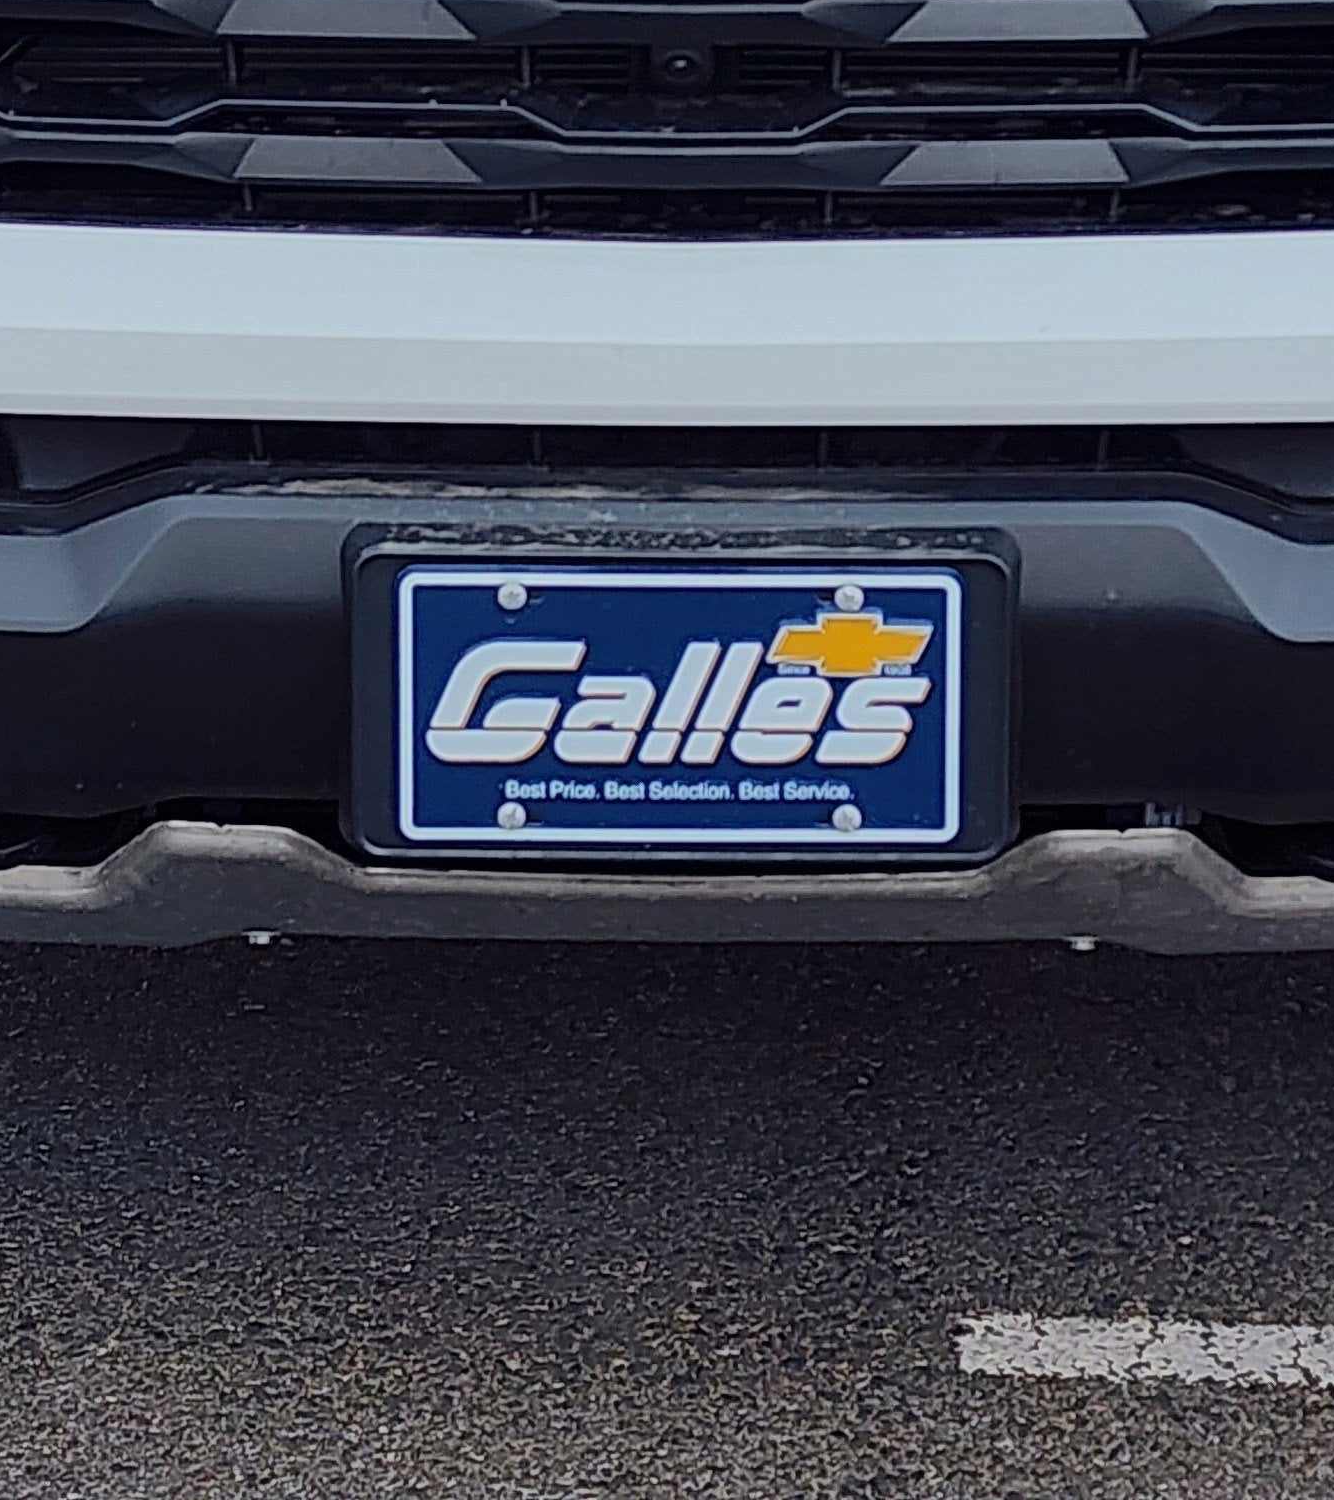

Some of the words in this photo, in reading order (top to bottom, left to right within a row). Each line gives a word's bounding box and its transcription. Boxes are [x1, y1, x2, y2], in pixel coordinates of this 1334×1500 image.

[425, 640, 932, 764] Galles
[505, 779, 546, 799] Best
[550, 780, 600, 800] Price.
[604, 780, 645, 800] Best
[649, 780, 735, 800] Selection.
[739, 780, 780, 800] Best
[784, 780, 856, 800] Service.
